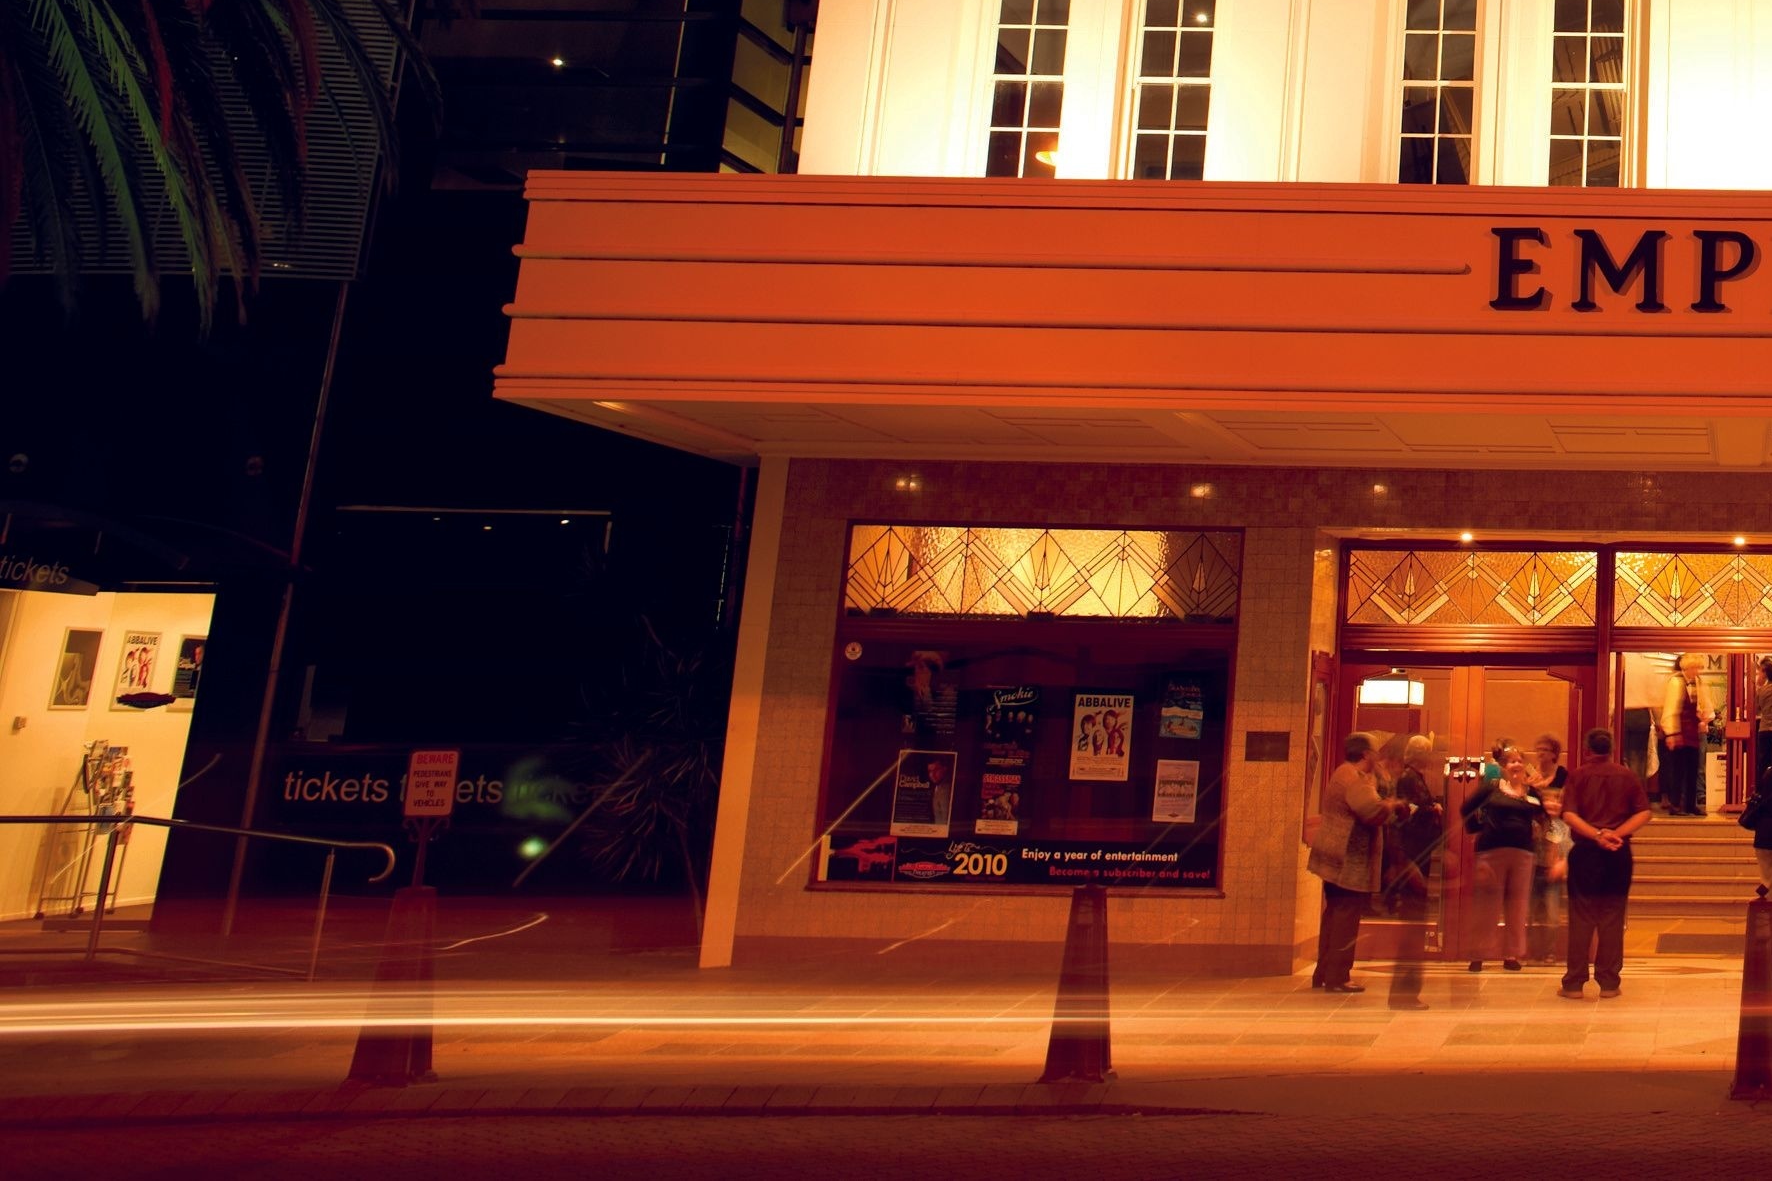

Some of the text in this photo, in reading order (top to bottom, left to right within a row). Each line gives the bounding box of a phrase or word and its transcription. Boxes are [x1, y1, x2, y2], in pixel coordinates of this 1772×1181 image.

[991, 686, 1036, 710] Smokie
[1078, 697, 1131, 708] ABBALIVE
[416, 754, 454, 764] BEWARE
[413, 770, 451, 778] PEDESTRIANS
[283, 770, 390, 804] tickets
[434, 780, 448, 788] WAY
[414, 799, 445, 807] VEHICLES
[1021, 847, 1178, 862] Enjoy a year of entertainment
[953, 852, 1008, 876] 2010
[1049, 865, 1089, 877] Become
[1103, 866, 1156, 878] subscriber
[1159, 867, 1179, 879] and
[1182, 869, 1210, 880] save!
